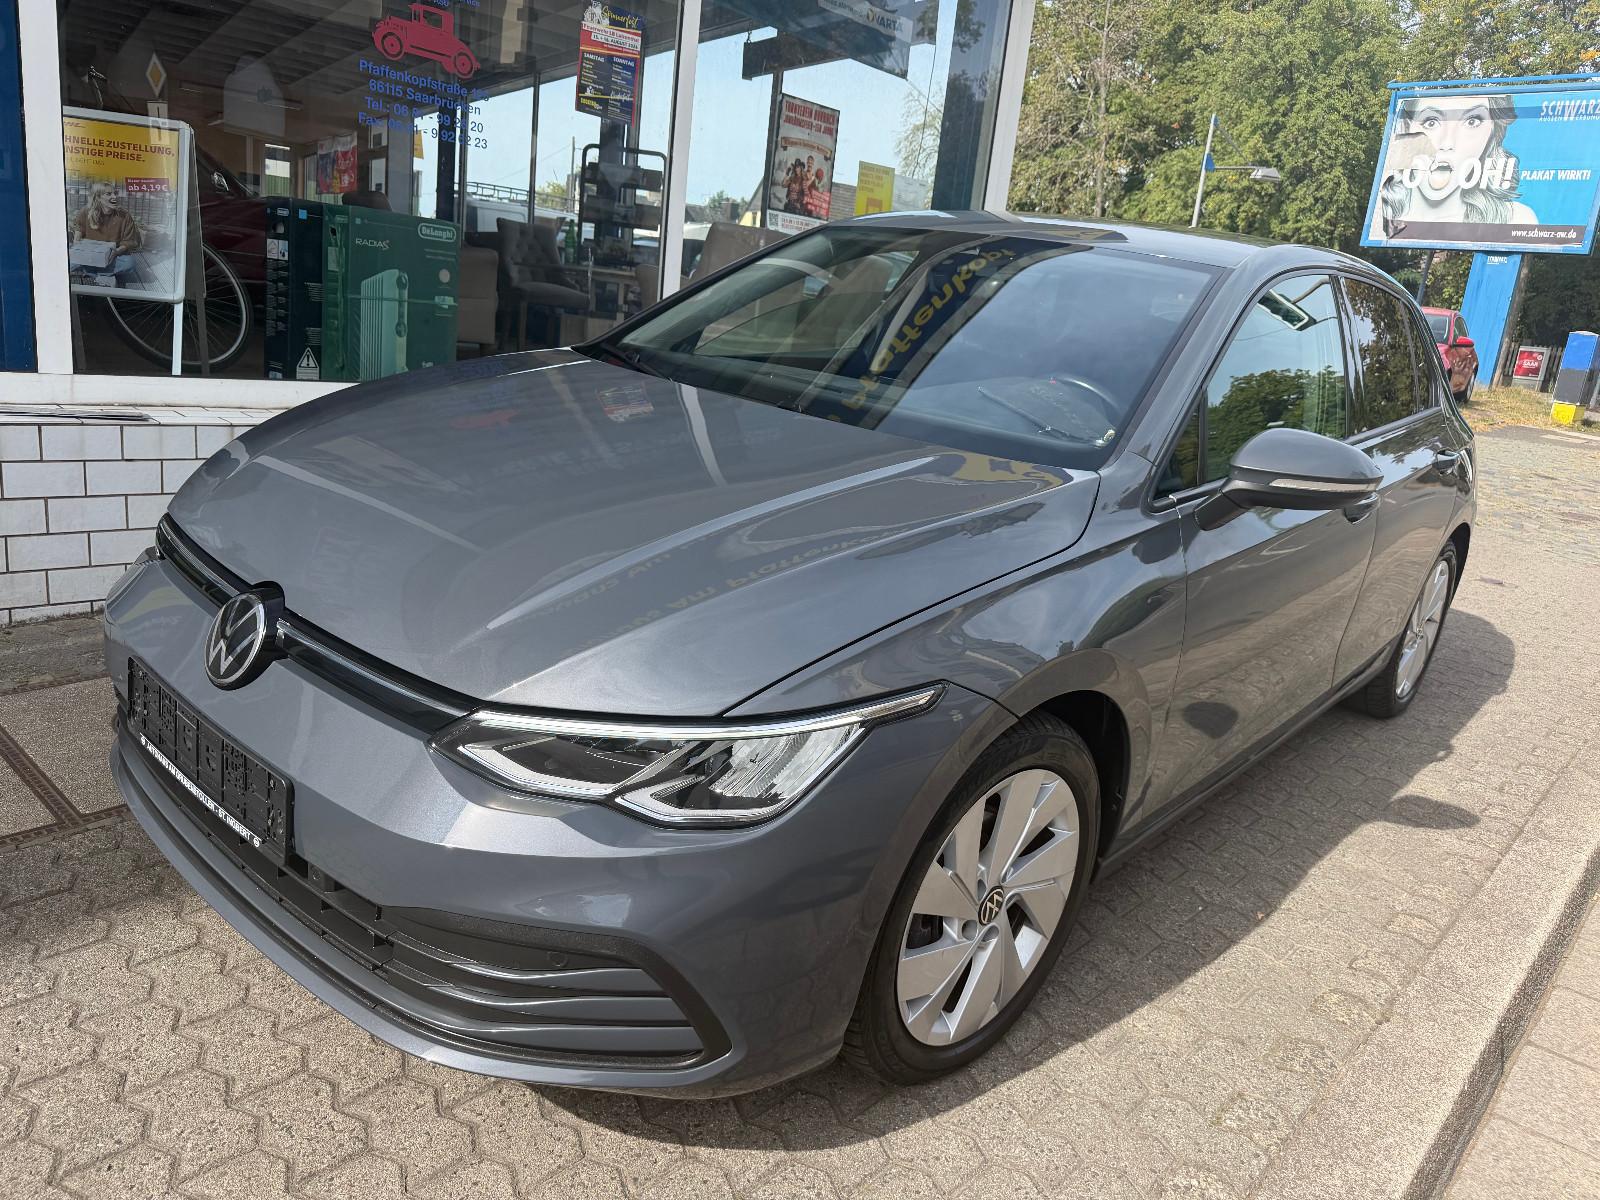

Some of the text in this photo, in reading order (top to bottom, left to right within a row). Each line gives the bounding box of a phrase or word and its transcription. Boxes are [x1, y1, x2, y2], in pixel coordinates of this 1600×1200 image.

[874, 13, 904, 32] VARTA
[359, 58, 467, 97] Pfaffenkopfstraße
[369, 79, 403, 97] 66115
[406, 87, 481, 115] Saarbrücken
[437, 113, 451, 126] 99
[470, 120, 484, 133] 20
[64, 134, 175, 157] HNELLE ZUSTELLUNG,
[441, 129, 455, 143] 92
[474, 137, 488, 149] 23
[65, 145, 104, 157] NSTIGE
[105, 150, 145, 162] PREISE.
[1520, 168, 1592, 181] PLAKAT WIRKT!
[421, 226, 454, 239] DeLonghi
[1511, 227, 1577, 239] www.schwarz-aw.de
